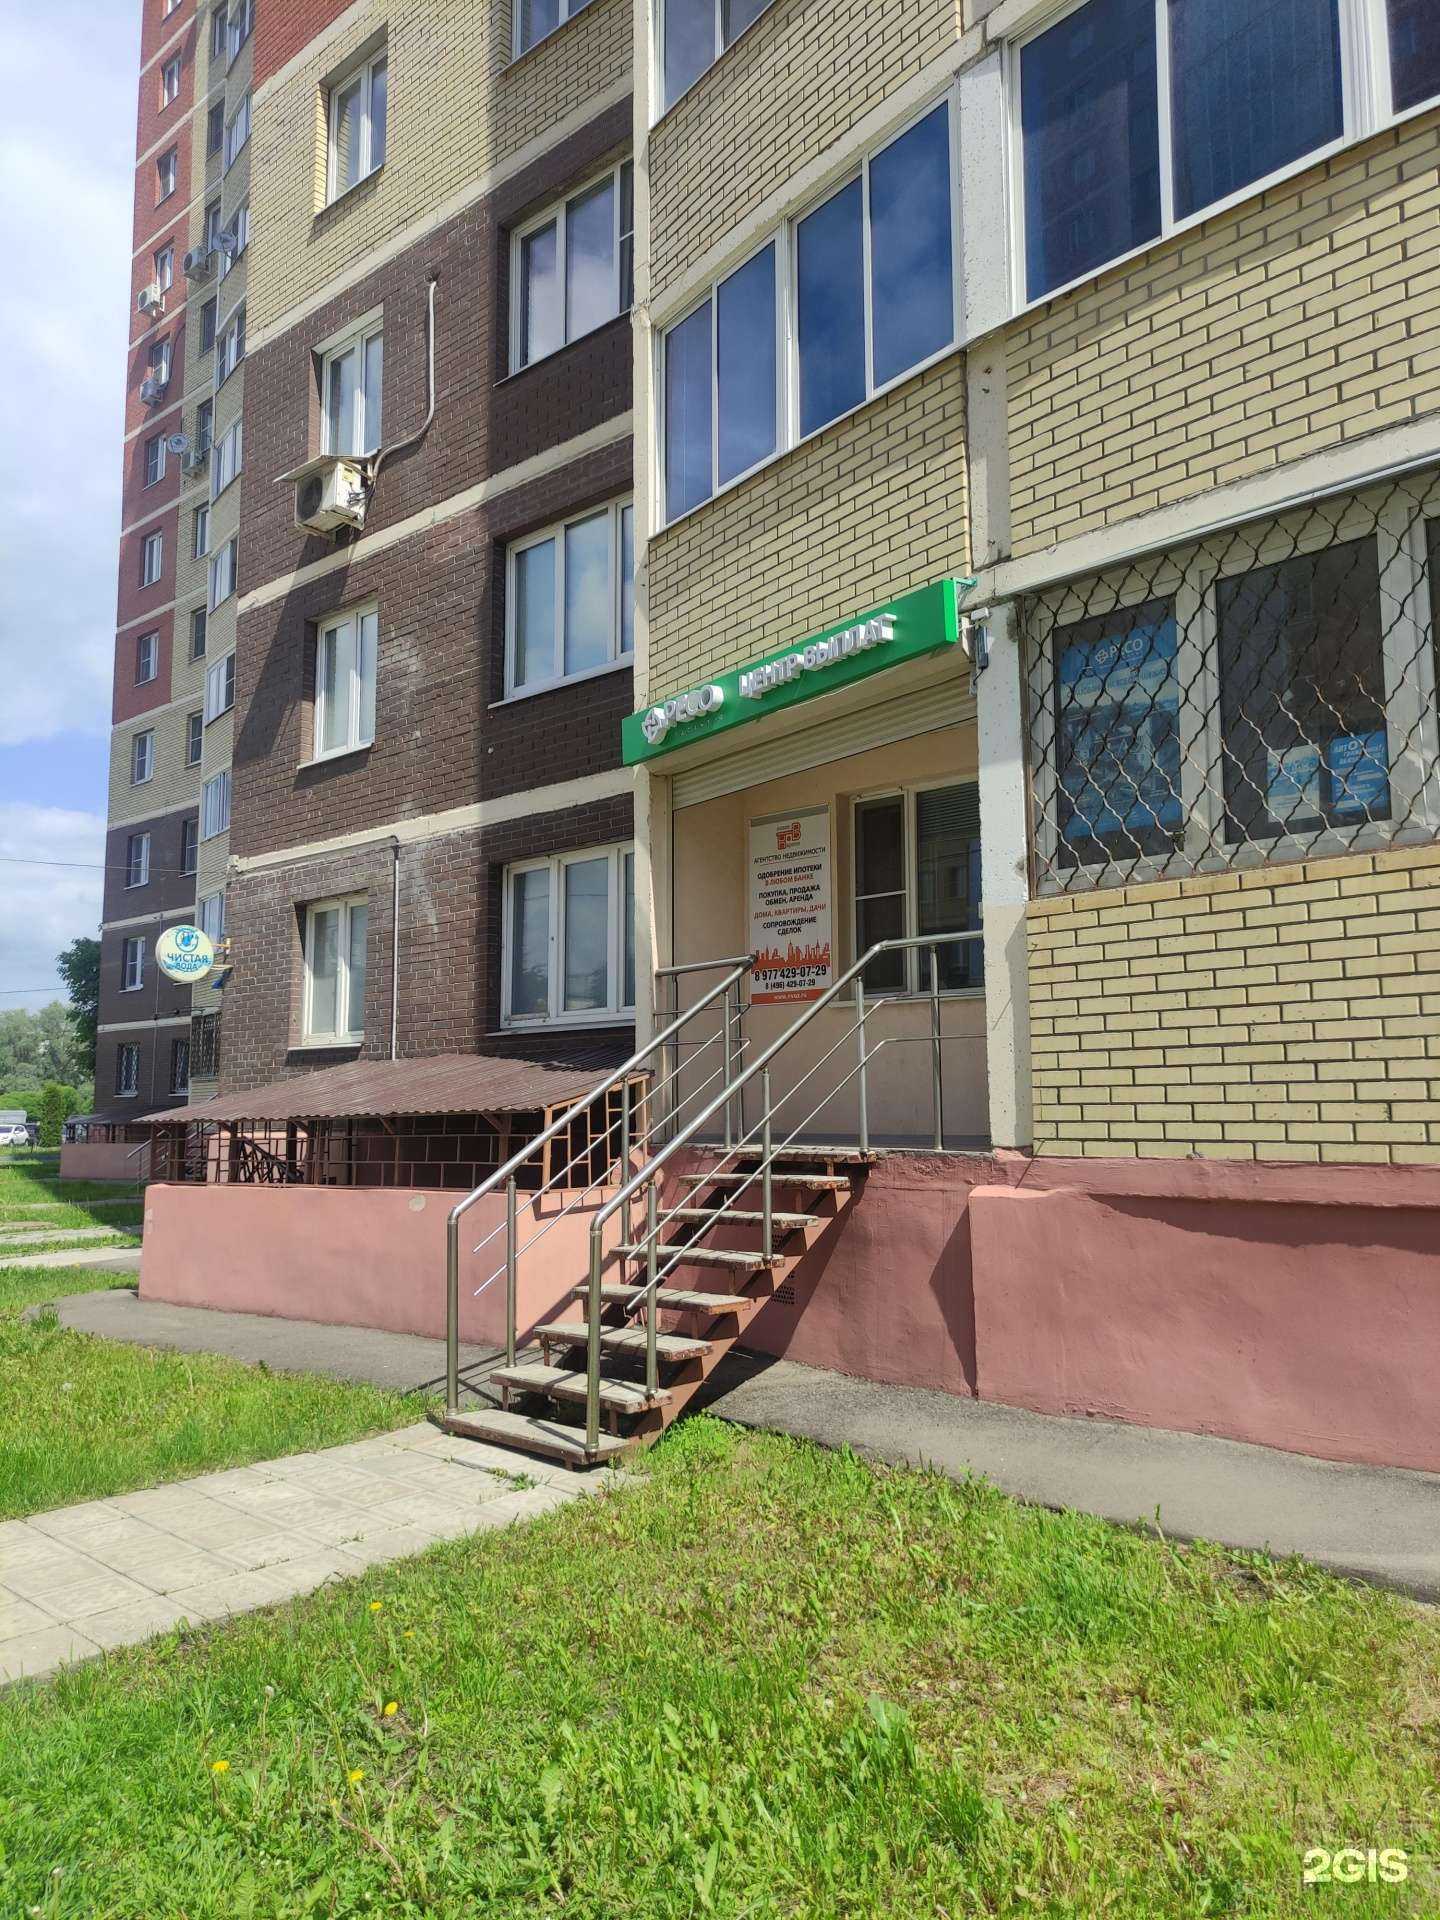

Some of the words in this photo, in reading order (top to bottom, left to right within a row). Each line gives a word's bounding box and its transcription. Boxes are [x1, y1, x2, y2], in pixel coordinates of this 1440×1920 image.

[1110, 638, 1143, 658] РСО
[664, 685, 724, 727] РЕСО
[739, 653, 804, 699] ЦЕНТР
[803, 613, 897, 671] ВЫПЛАТ
[782, 847, 826, 860] НЕДВИЖИМОСТИ
[757, 868, 792, 880] ОДОБРЕНИЕ
[793, 864, 822, 874] ИПОТЕКИ
[768, 877, 794, 885] ЛЮБОМ
[794, 874, 814, 882] БАНКЕ
[789, 884, 821, 895] ПРОДАЖА
[789, 894, 814, 903] АРЕНДА
[809, 903, 826, 912] ДАЧИ
[762, 916, 817, 929] СОПРОВОЖДЕНИЕ
[778, 927, 802, 936] СДЕЛОК
[167, 953, 208, 963] ЧИСТАЯ
[762, 969, 778, 981] 977
[780, 965, 827, 979] 429-07-29
